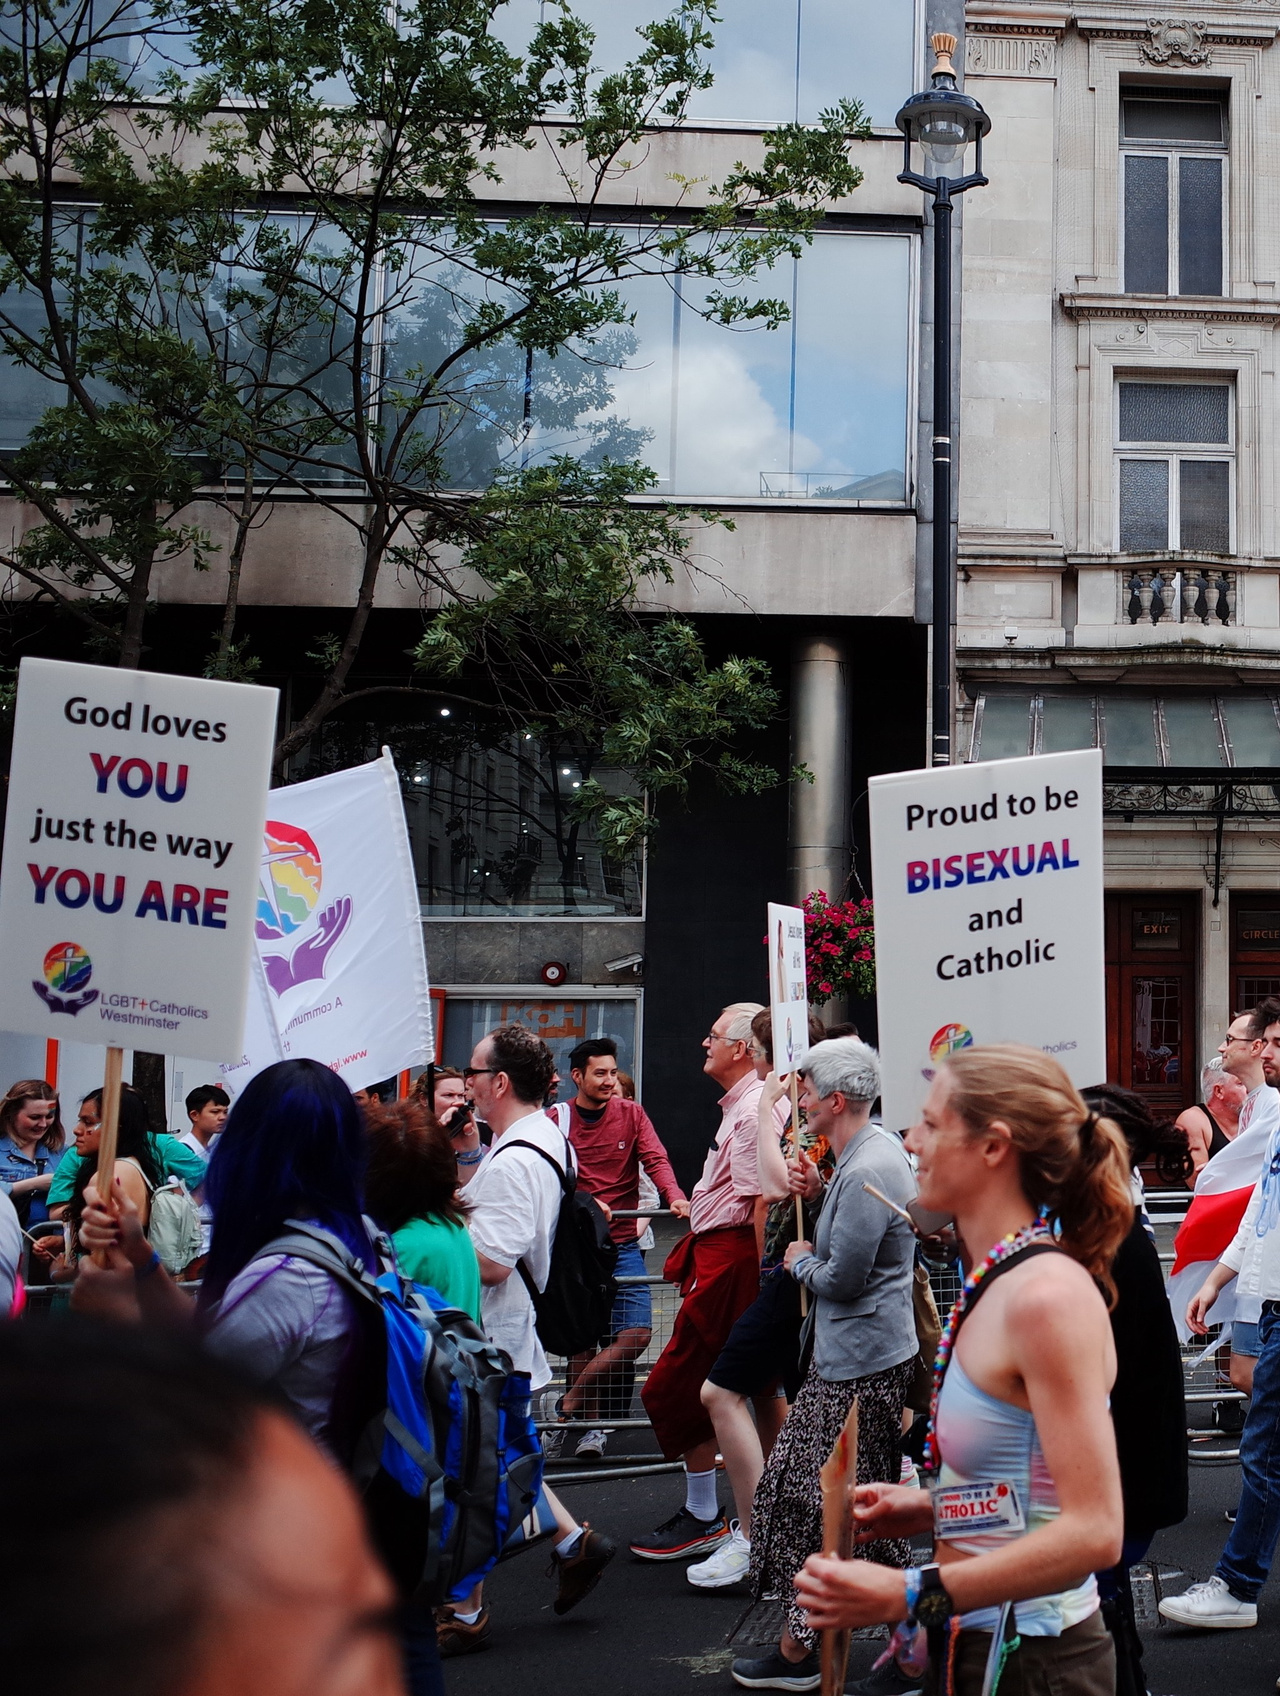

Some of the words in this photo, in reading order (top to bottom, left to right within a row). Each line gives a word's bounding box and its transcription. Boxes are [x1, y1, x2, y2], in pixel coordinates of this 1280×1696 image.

[64, 697, 131, 731] God
[141, 704, 228, 743] loves
[89, 752, 189, 803] YOU
[906, 793, 998, 831] Proud
[1007, 792, 1036, 817] to
[1045, 785, 1079, 812] be
[30, 809, 95, 844] just
[103, 819, 157, 852] the
[166, 834, 233, 868] way
[907, 838, 1079, 894] BISEXUAL
[27, 863, 126, 915] YOU
[135, 880, 229, 929] ARE
[968, 898, 1023, 932] and
[1144, 925, 1170, 934] EXIT
[1242, 930, 1280, 939] CIRCLE
[936, 939, 1056, 981] Catholic
[100, 1008, 180, 1031] Westminster
[101, 993, 208, 1020] LGBT+Catholics
[938, 1499, 998, 1519] ATHOLIC
[986, 1490, 991, 1498] A
